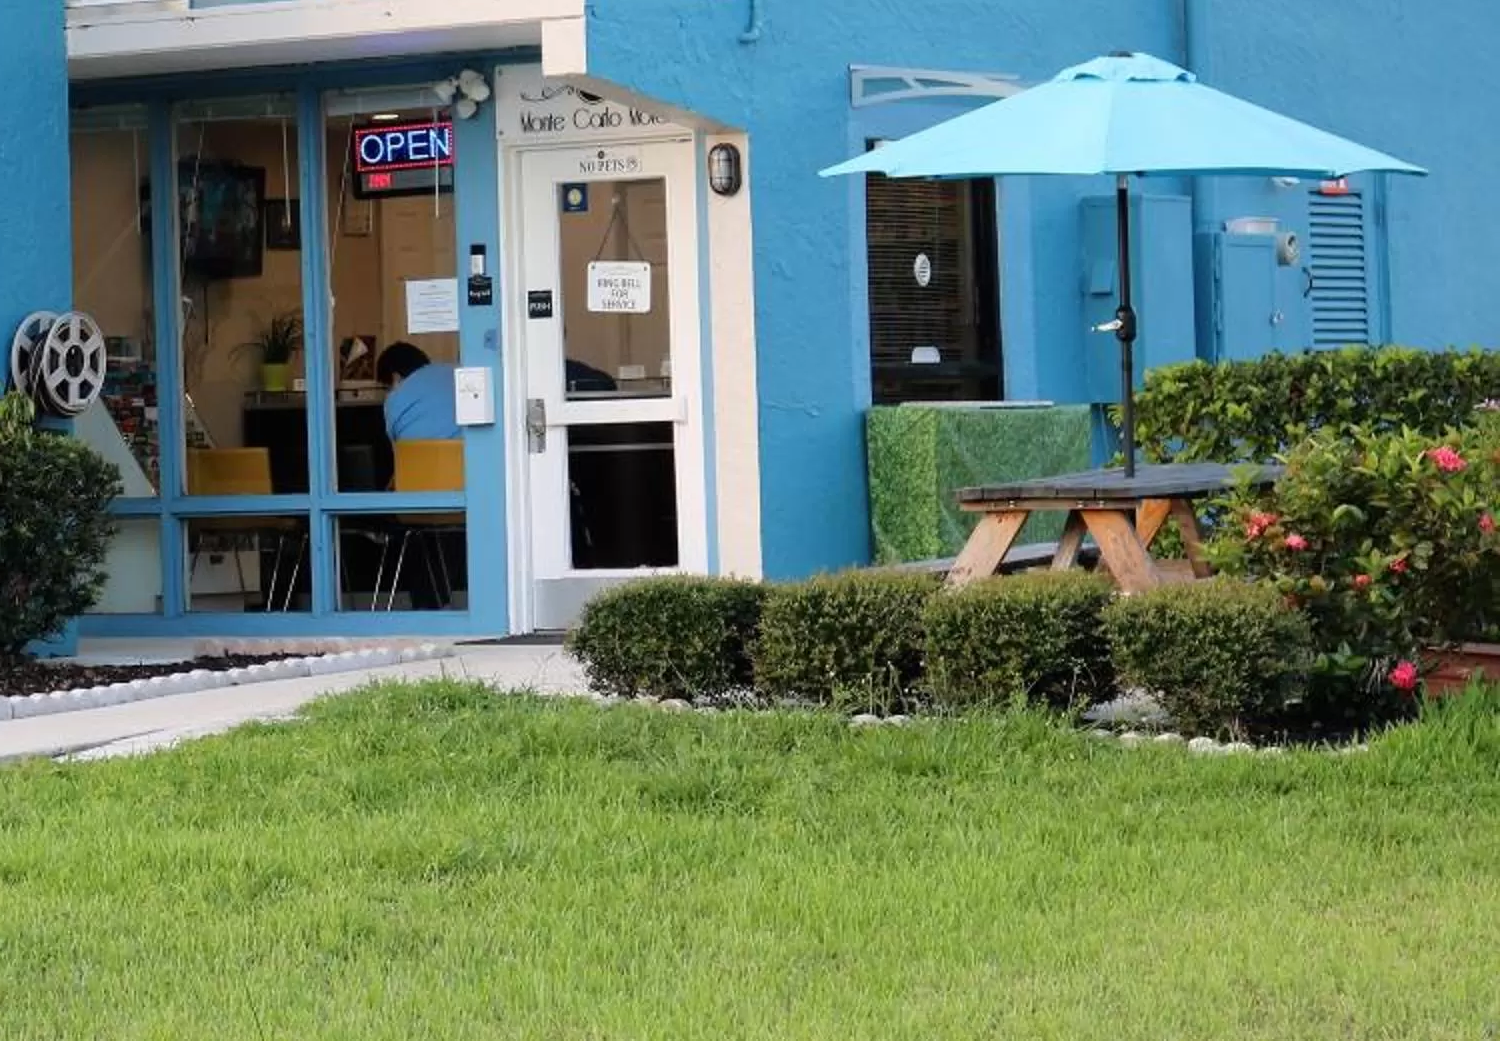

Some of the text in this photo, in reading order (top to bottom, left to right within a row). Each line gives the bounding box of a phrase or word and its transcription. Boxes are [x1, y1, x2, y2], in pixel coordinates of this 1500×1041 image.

[520, 111, 566, 132] Monte
[573, 107, 622, 129] Carlo
[361, 128, 450, 164] OPEN
[579, 159, 626, 174] NO PETS
[597, 278, 640, 288] RING BELL
[611, 289, 629, 299] FOR
[602, 300, 636, 309] SERVICE
